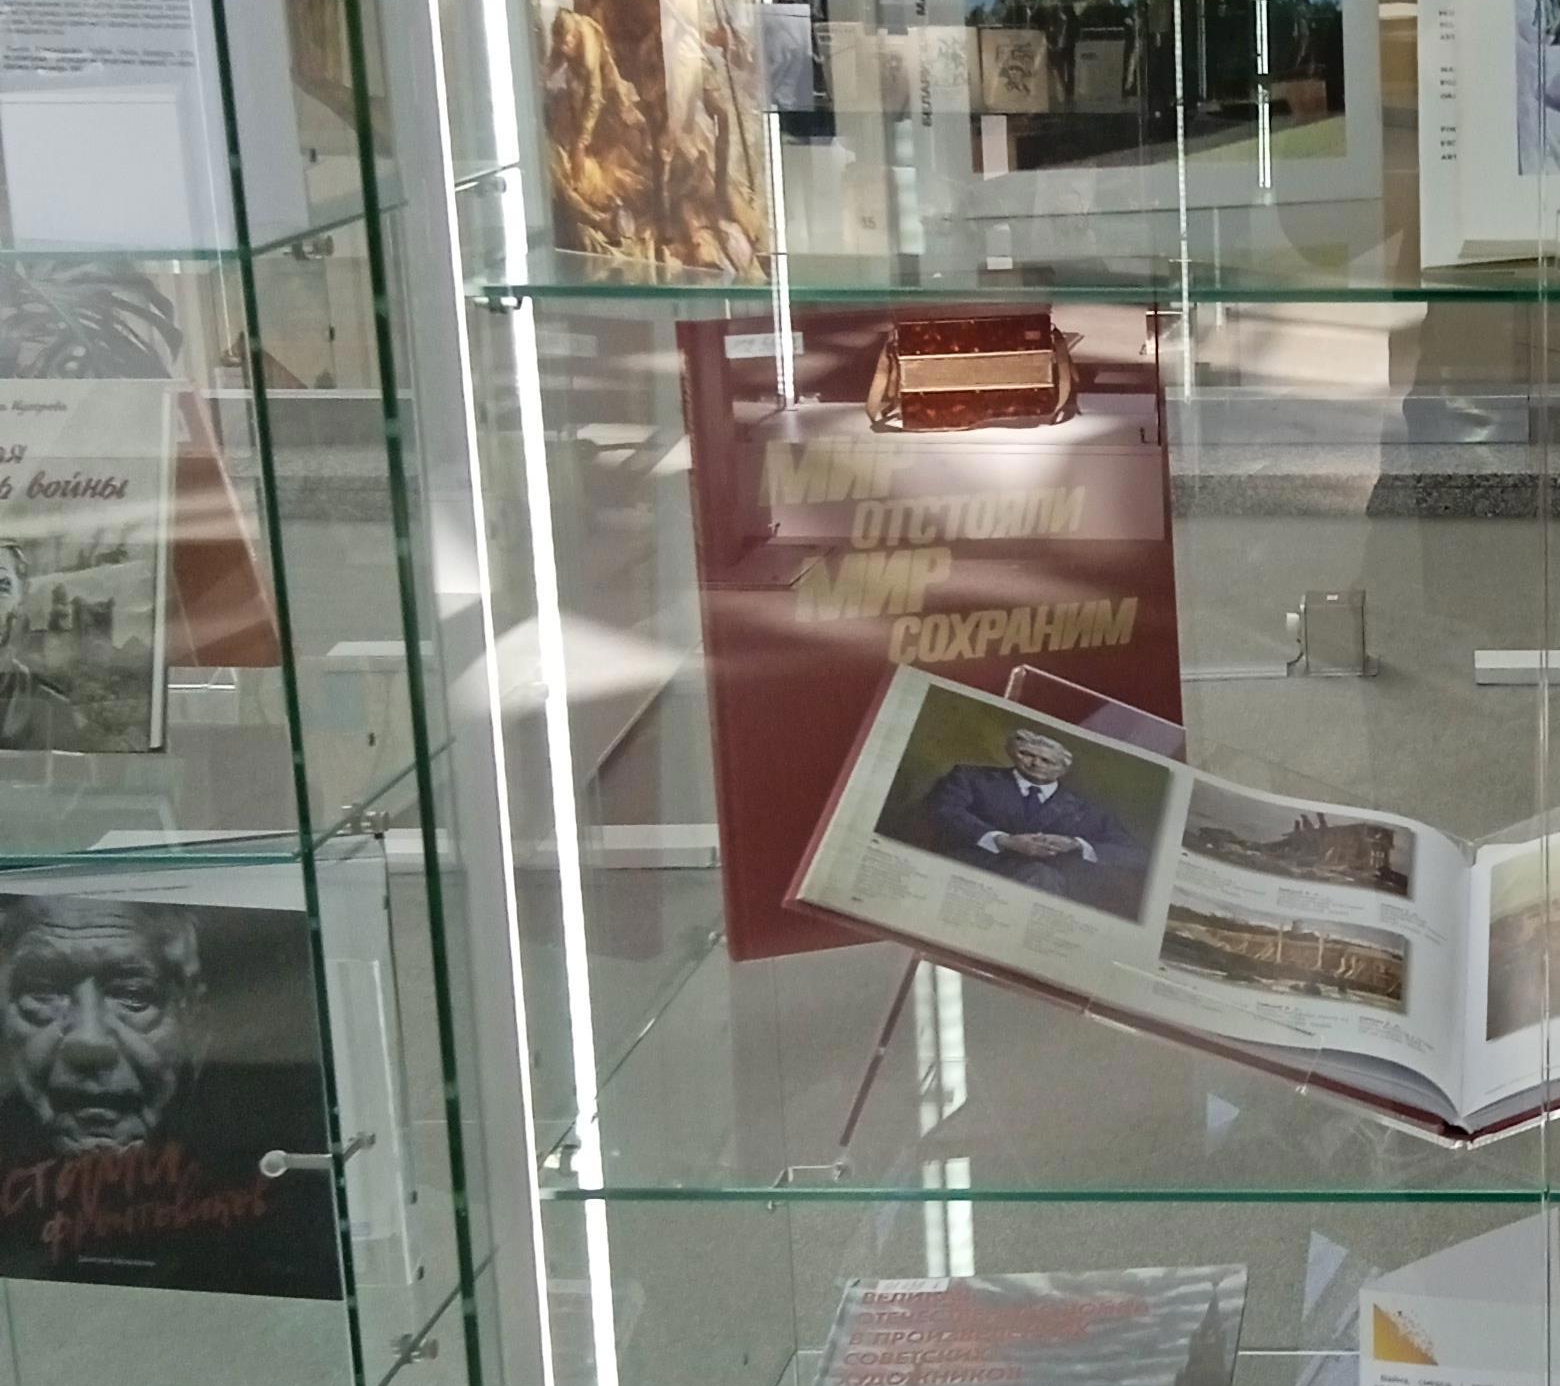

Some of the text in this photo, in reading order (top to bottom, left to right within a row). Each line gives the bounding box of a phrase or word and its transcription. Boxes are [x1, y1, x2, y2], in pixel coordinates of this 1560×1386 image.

[26, 471, 129, 500] войны
[850, 485, 1086, 550] ОТСТОЯЛИ
[795, 547, 953, 623] МИР
[888, 597, 1139, 666] СОХРАНИМ
